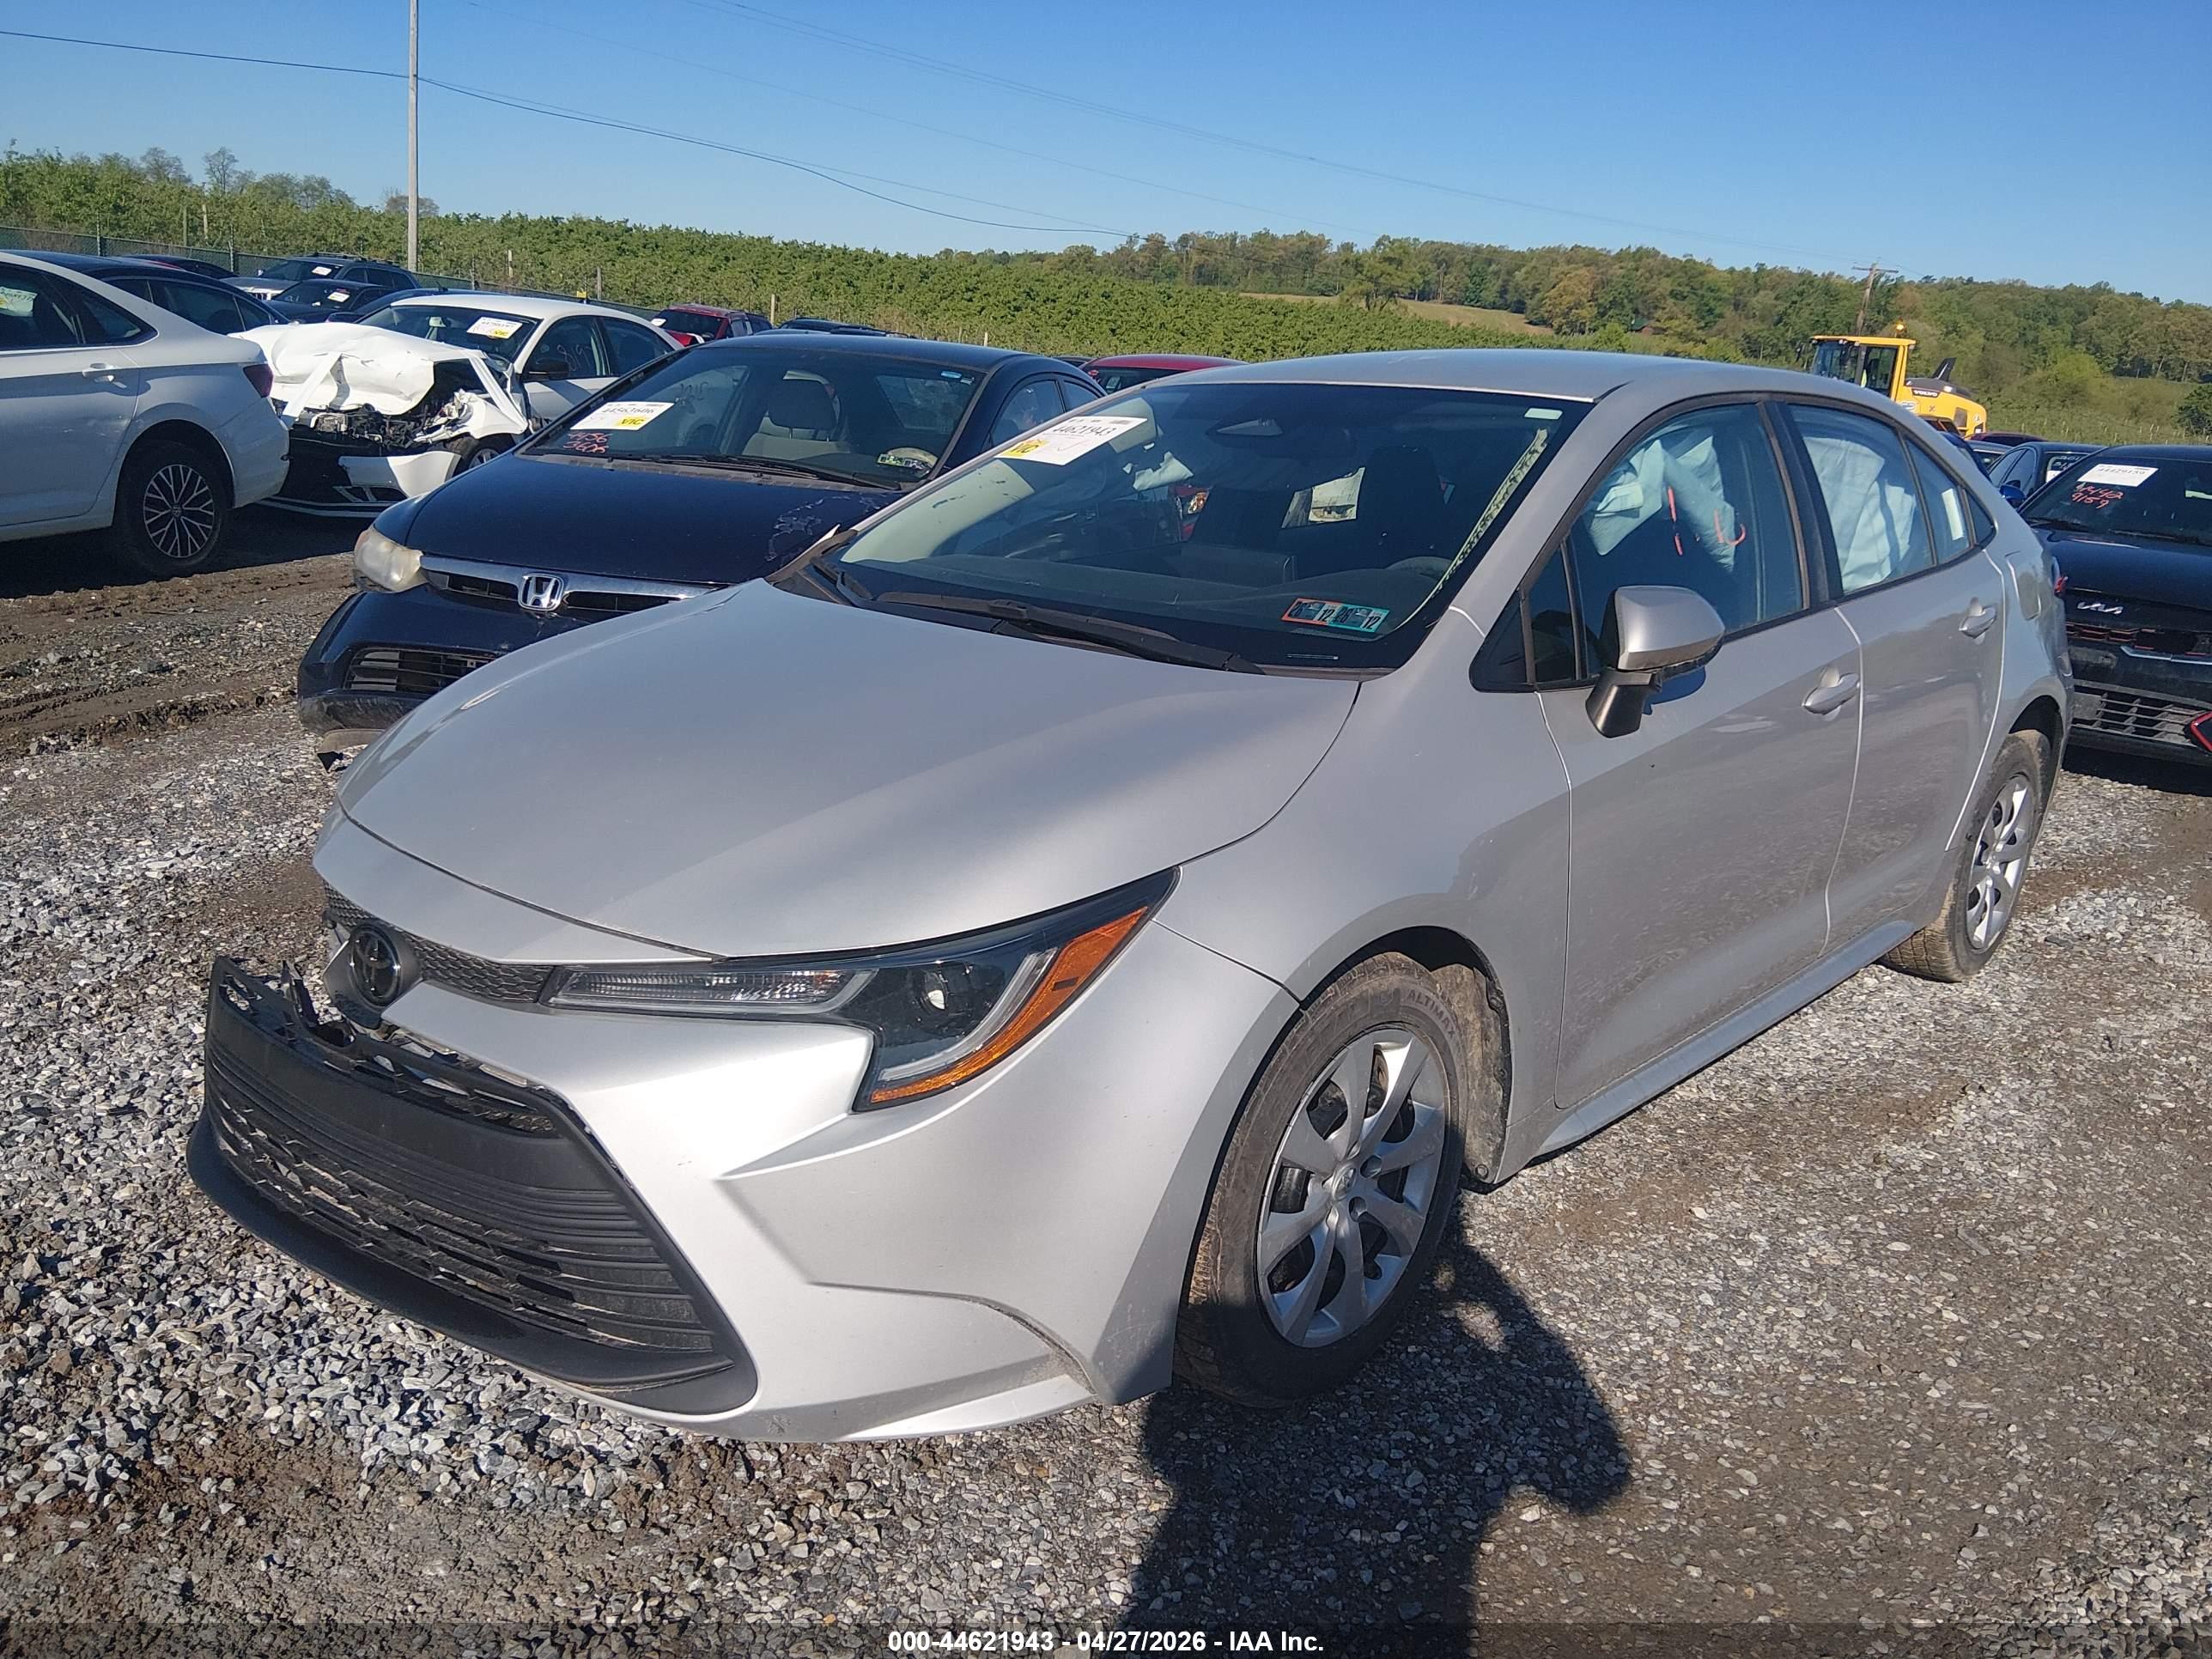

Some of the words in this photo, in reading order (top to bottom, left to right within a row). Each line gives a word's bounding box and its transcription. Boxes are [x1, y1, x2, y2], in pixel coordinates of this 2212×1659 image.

[1053, 426, 1117, 436] 44621943
[1316, 609, 1335, 622] 12
[1361, 616, 1382, 629] 12
